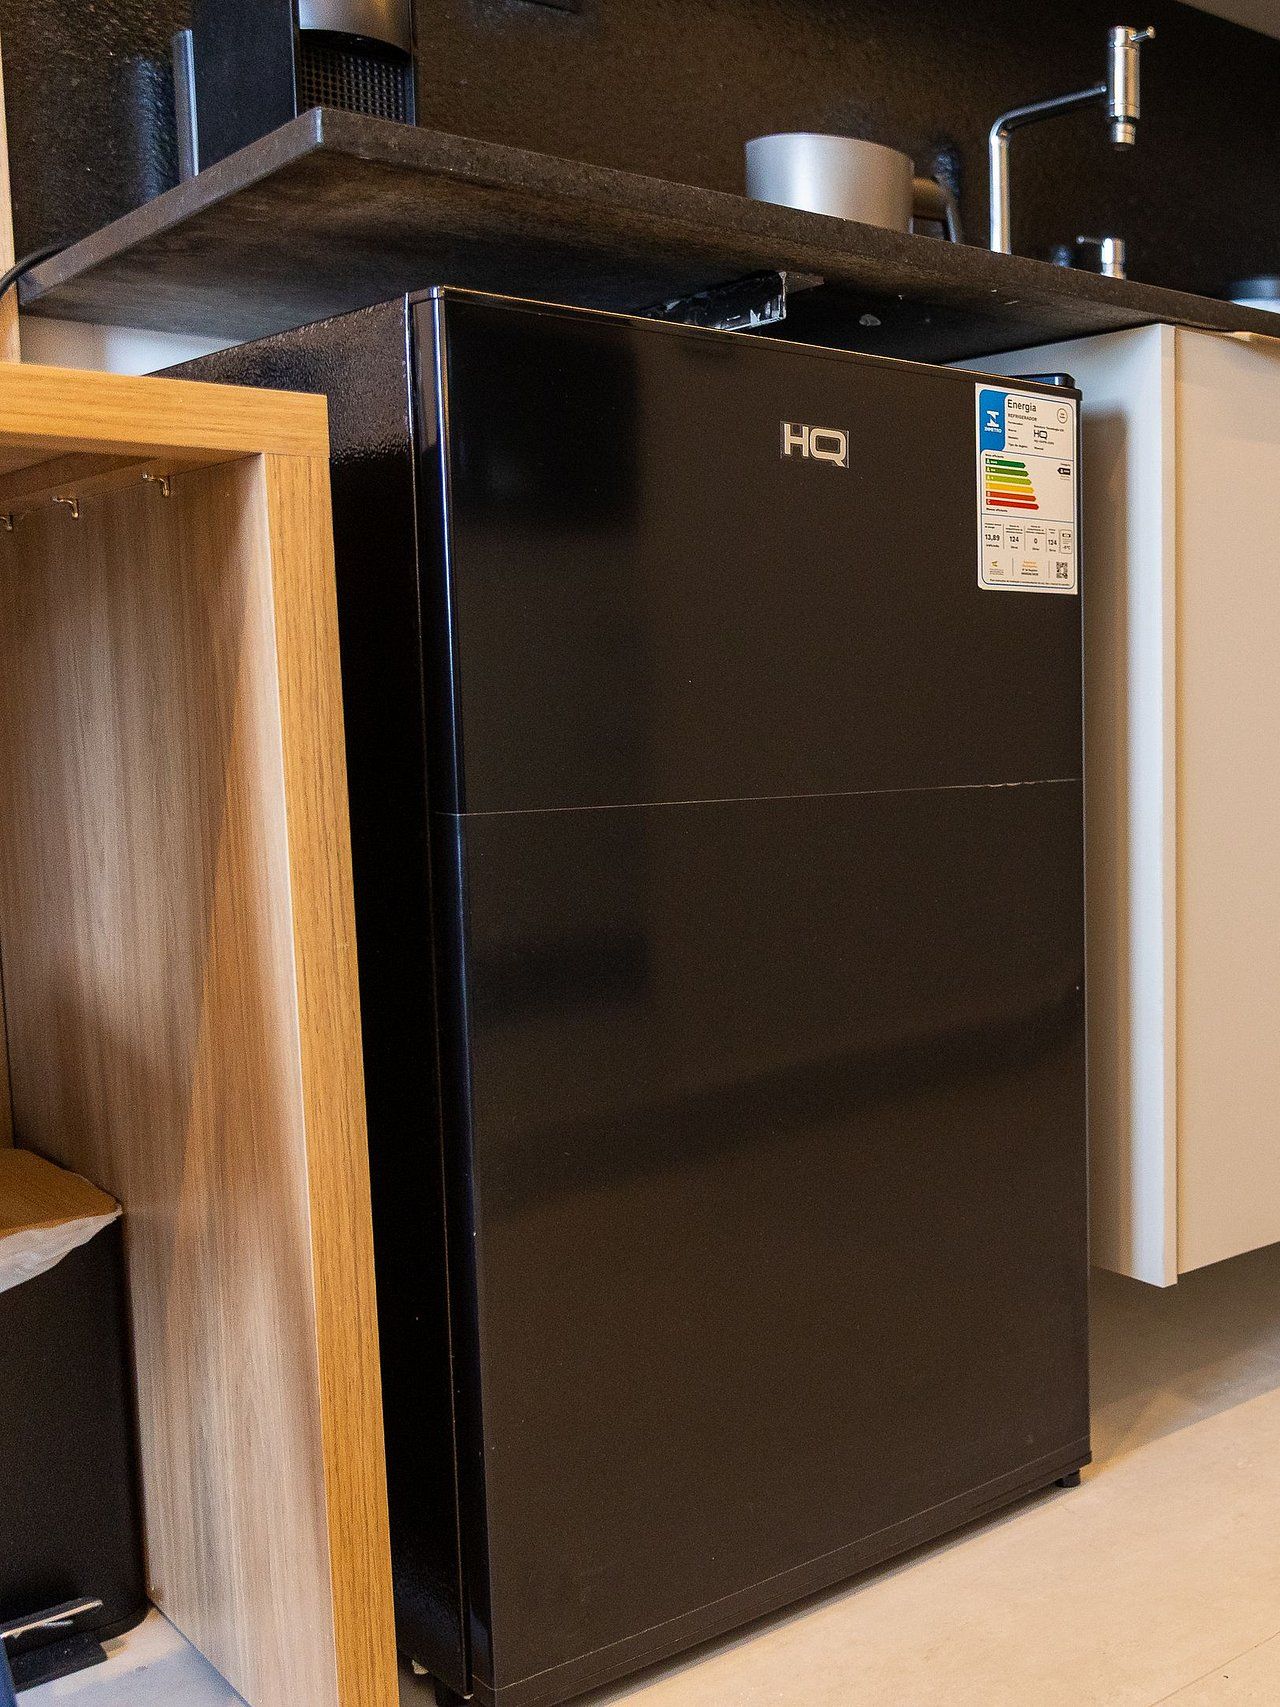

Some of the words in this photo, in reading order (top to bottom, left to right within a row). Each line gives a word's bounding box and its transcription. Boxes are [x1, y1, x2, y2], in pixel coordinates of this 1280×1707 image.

[1007, 399, 1037, 413] Energia
[1033, 429, 1048, 440] HQ
[784, 423, 846, 467] HQ
